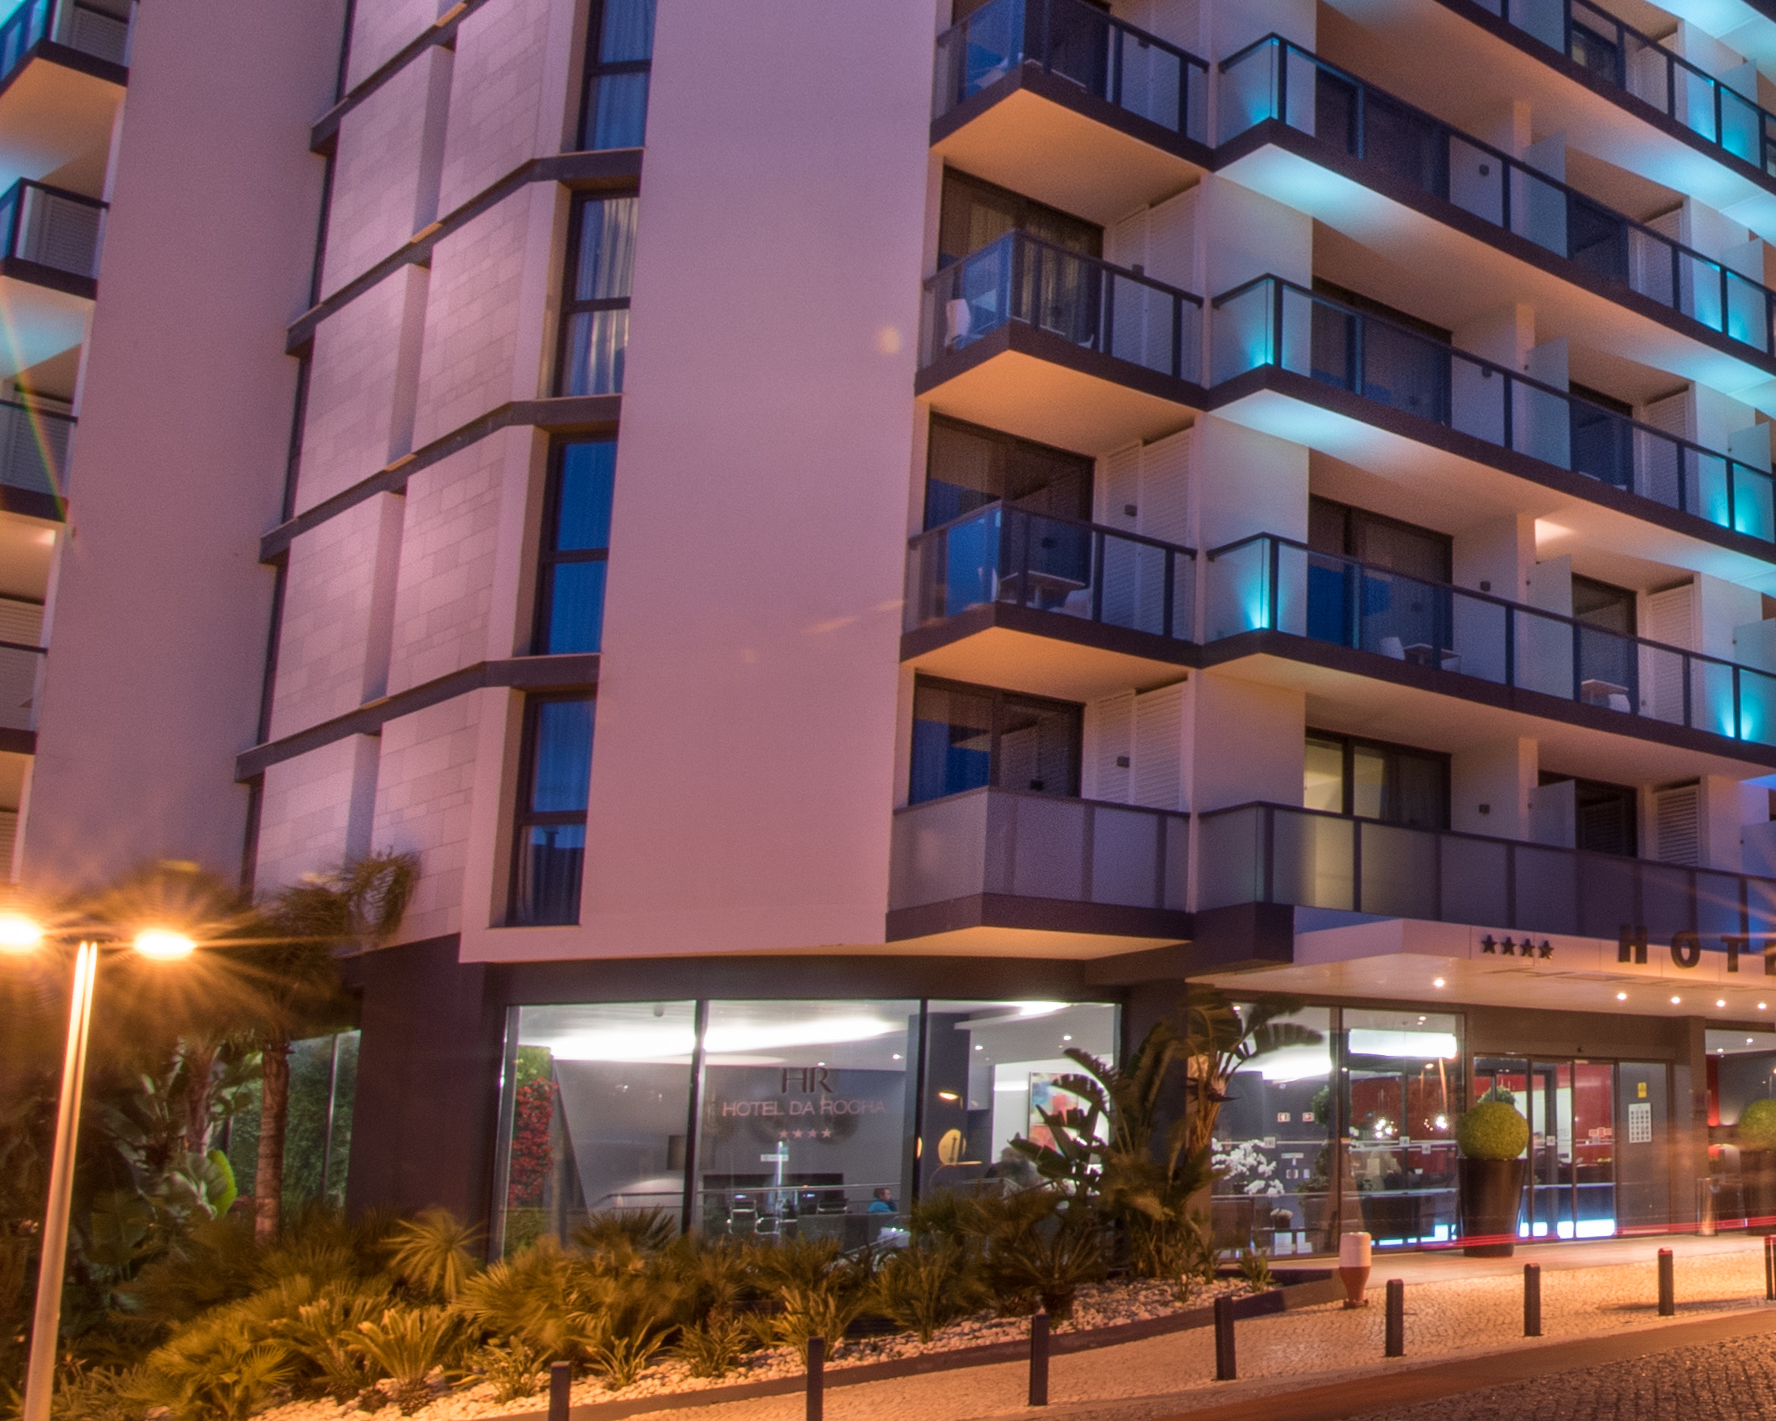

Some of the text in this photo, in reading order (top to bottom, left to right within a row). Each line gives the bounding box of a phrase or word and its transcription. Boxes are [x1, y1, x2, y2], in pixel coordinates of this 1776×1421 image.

[781, 1066, 833, 1094] HR
[722, 1099, 887, 1117] HOTEL DA ROCHA
